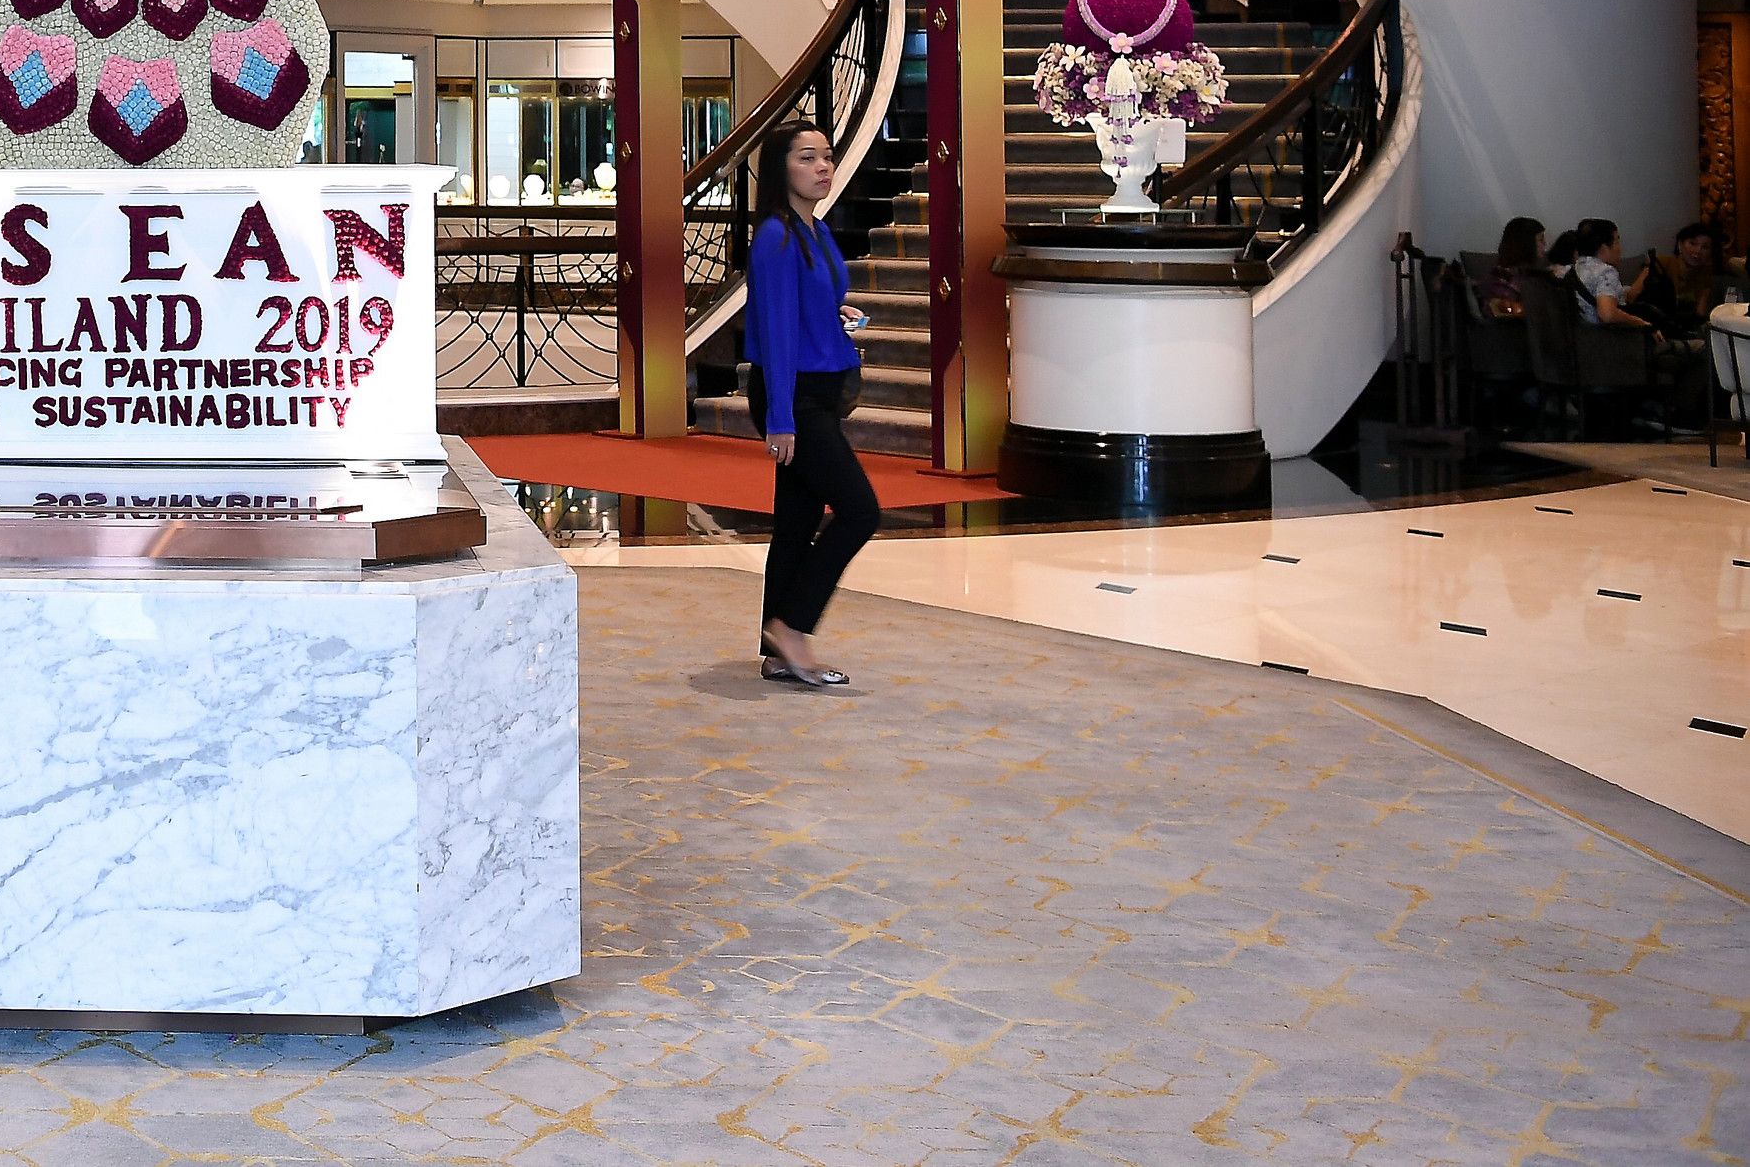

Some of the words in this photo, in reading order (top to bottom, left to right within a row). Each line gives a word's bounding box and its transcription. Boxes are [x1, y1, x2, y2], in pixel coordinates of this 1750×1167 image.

[255, 295, 395, 356] 2019
[104, 356, 375, 391] PARTNERSHIP
[34, 392, 352, 429] SUSTAINABILITY
